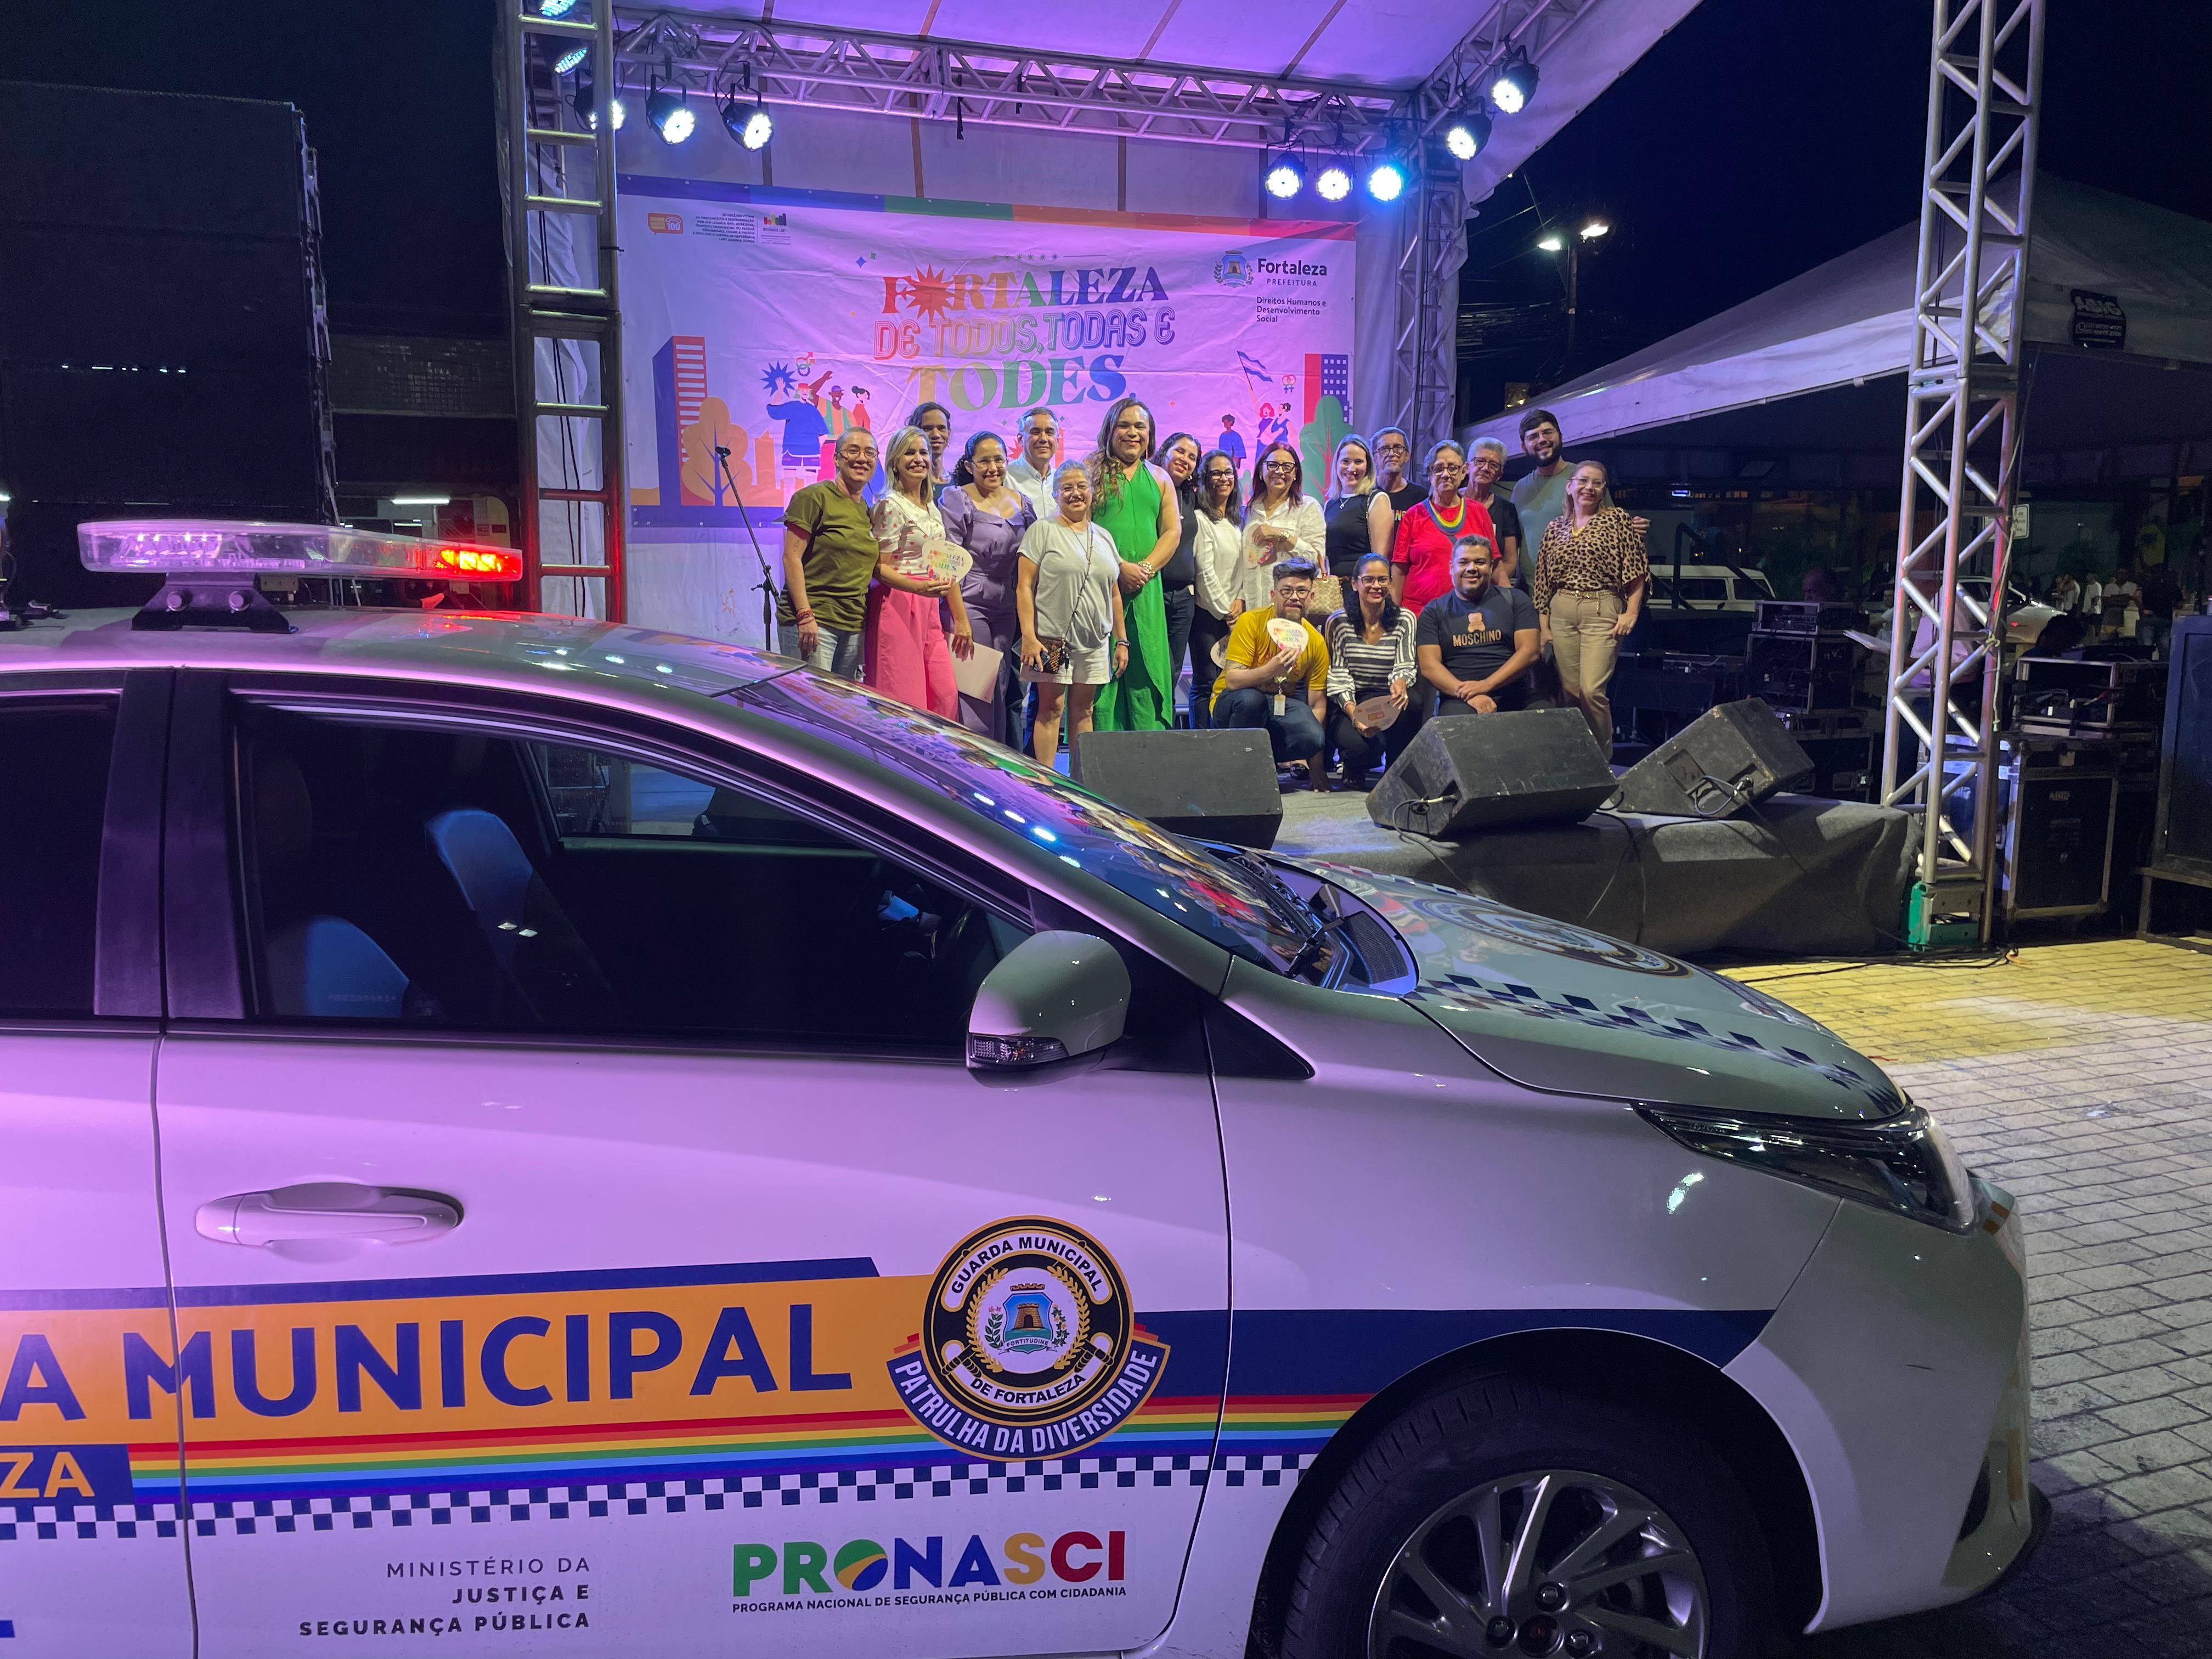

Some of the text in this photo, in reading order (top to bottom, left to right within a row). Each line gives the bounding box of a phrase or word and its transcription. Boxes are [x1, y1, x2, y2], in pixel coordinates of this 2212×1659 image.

[1258, 258, 1327, 276] Fortaleza
[882, 264, 1169, 320] FORTALEZA
[1267, 278, 1317, 287] PREFEITURA
[1256, 296, 1285, 304] Direitos
[1287, 298, 1321, 306] Humanos
[1256, 306, 1320, 315] Desenvolvimento
[873, 319, 921, 360] DE
[1043, 308, 1148, 351] TODAS
[1153, 306, 1175, 346] E
[1452, 629, 1502, 647] MOSCHINO
[951, 1236, 1103, 1295] GUARDA MUNICIPAL
[1006, 1338, 1049, 1348] FORTITUDINE
[123, 1304, 852, 1420] MUNICIPAL
[895, 1350, 1158, 1453] PATRULHA DA DIVERSIDADE
[970, 1374, 1086, 1404] DE FORTALEZA
[387, 1556, 590, 1578] MINISTÉRIO DA
[733, 1530, 1126, 1598] PRONASCI
[452, 1584, 590, 1606] JUSTIÇA E
[732, 1587, 1127, 1613] PROGRAMA NACIONAL DE SEGURANÇA PÚBLICA COM CIDADANIA
[299, 1611, 590, 1637] SEGURANÇA PÚBLICA
